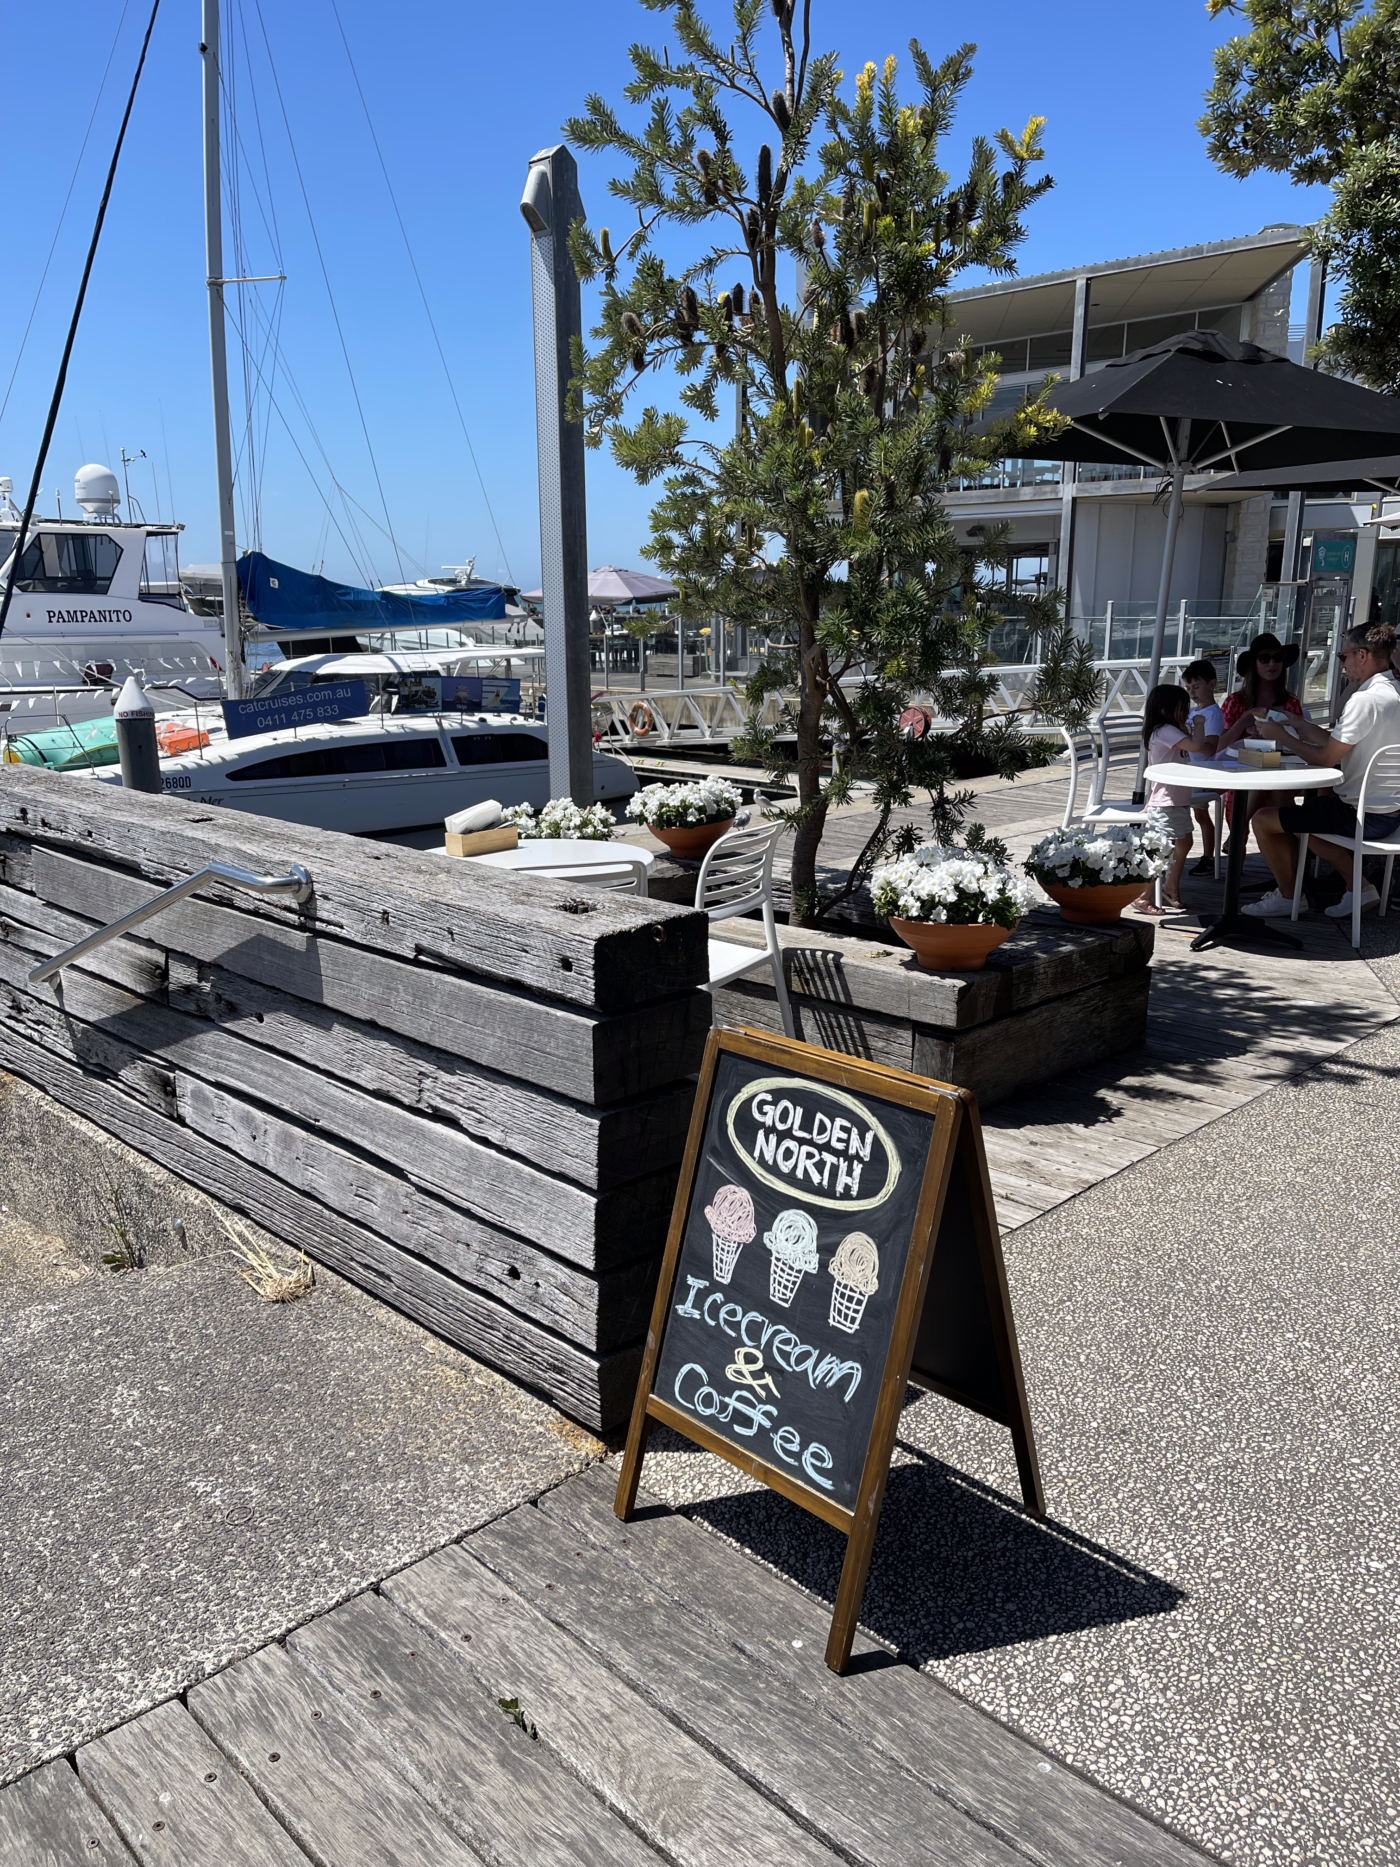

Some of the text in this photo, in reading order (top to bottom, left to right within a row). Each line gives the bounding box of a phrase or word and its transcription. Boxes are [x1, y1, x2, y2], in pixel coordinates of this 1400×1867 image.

[46, 609, 133, 623] PAMPANITO
[238, 687, 351, 715] catcruises.com.au
[257, 704, 339, 728] 0411 475 833
[751, 1092, 875, 1161] GOLDEN
[753, 1128, 864, 1198] NORTH
[675, 1275, 862, 1403] Icecream
[725, 1347, 781, 1400] &
[674, 1363, 835, 1490] Coffee
